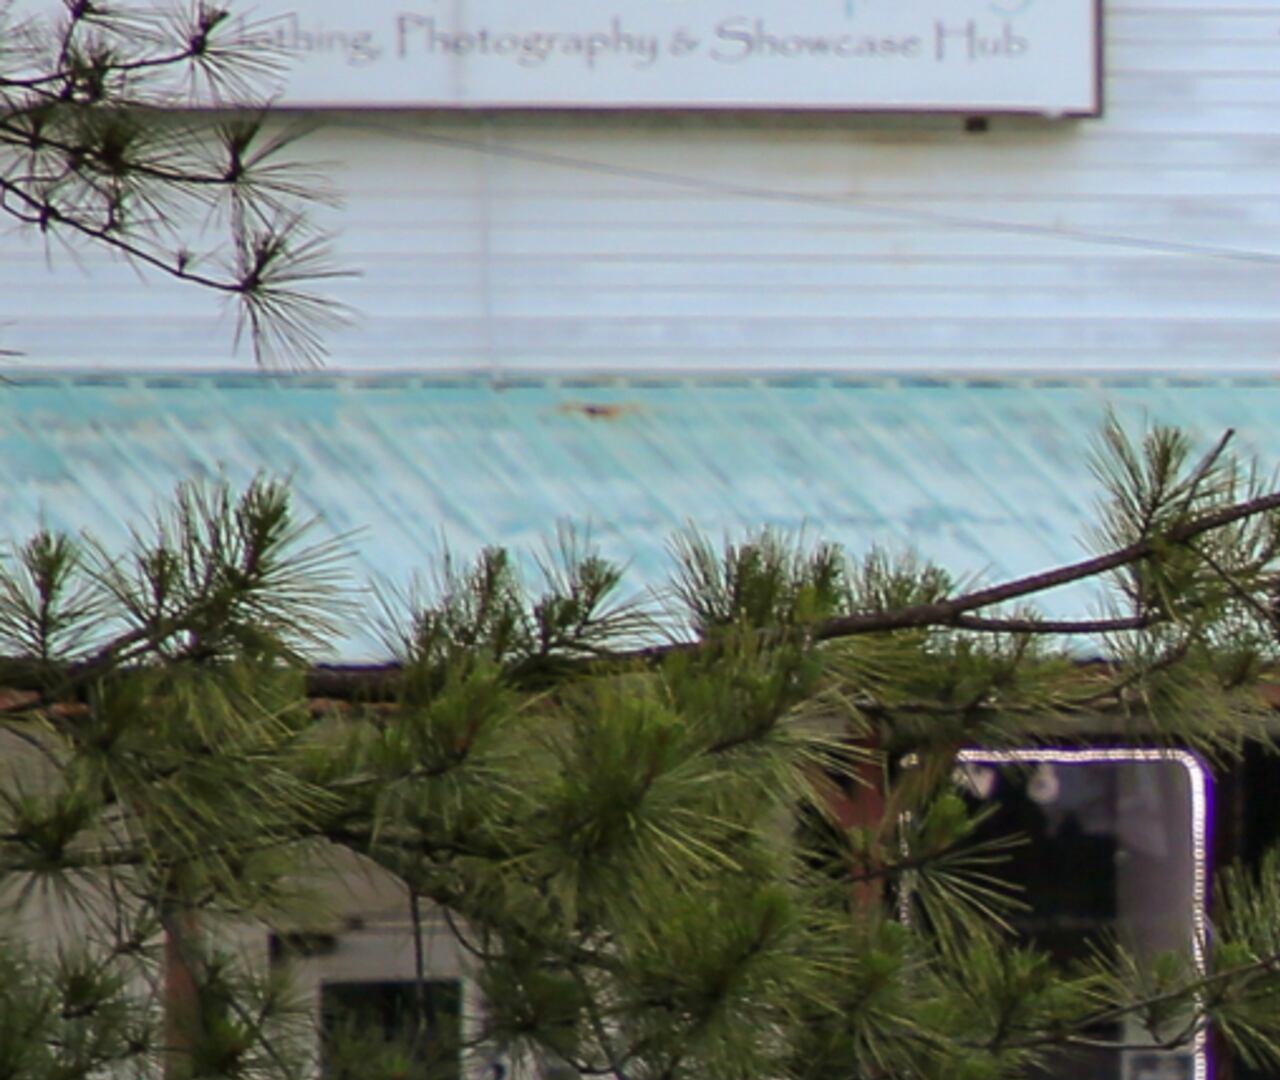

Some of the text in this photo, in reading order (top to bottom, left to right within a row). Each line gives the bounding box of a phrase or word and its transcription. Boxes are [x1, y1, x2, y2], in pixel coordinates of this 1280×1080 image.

[396, 12, 659, 71] Photography
[669, 26, 699, 56] &
[709, 15, 920, 63] Showcase
[933, 18, 1029, 62] Hub
